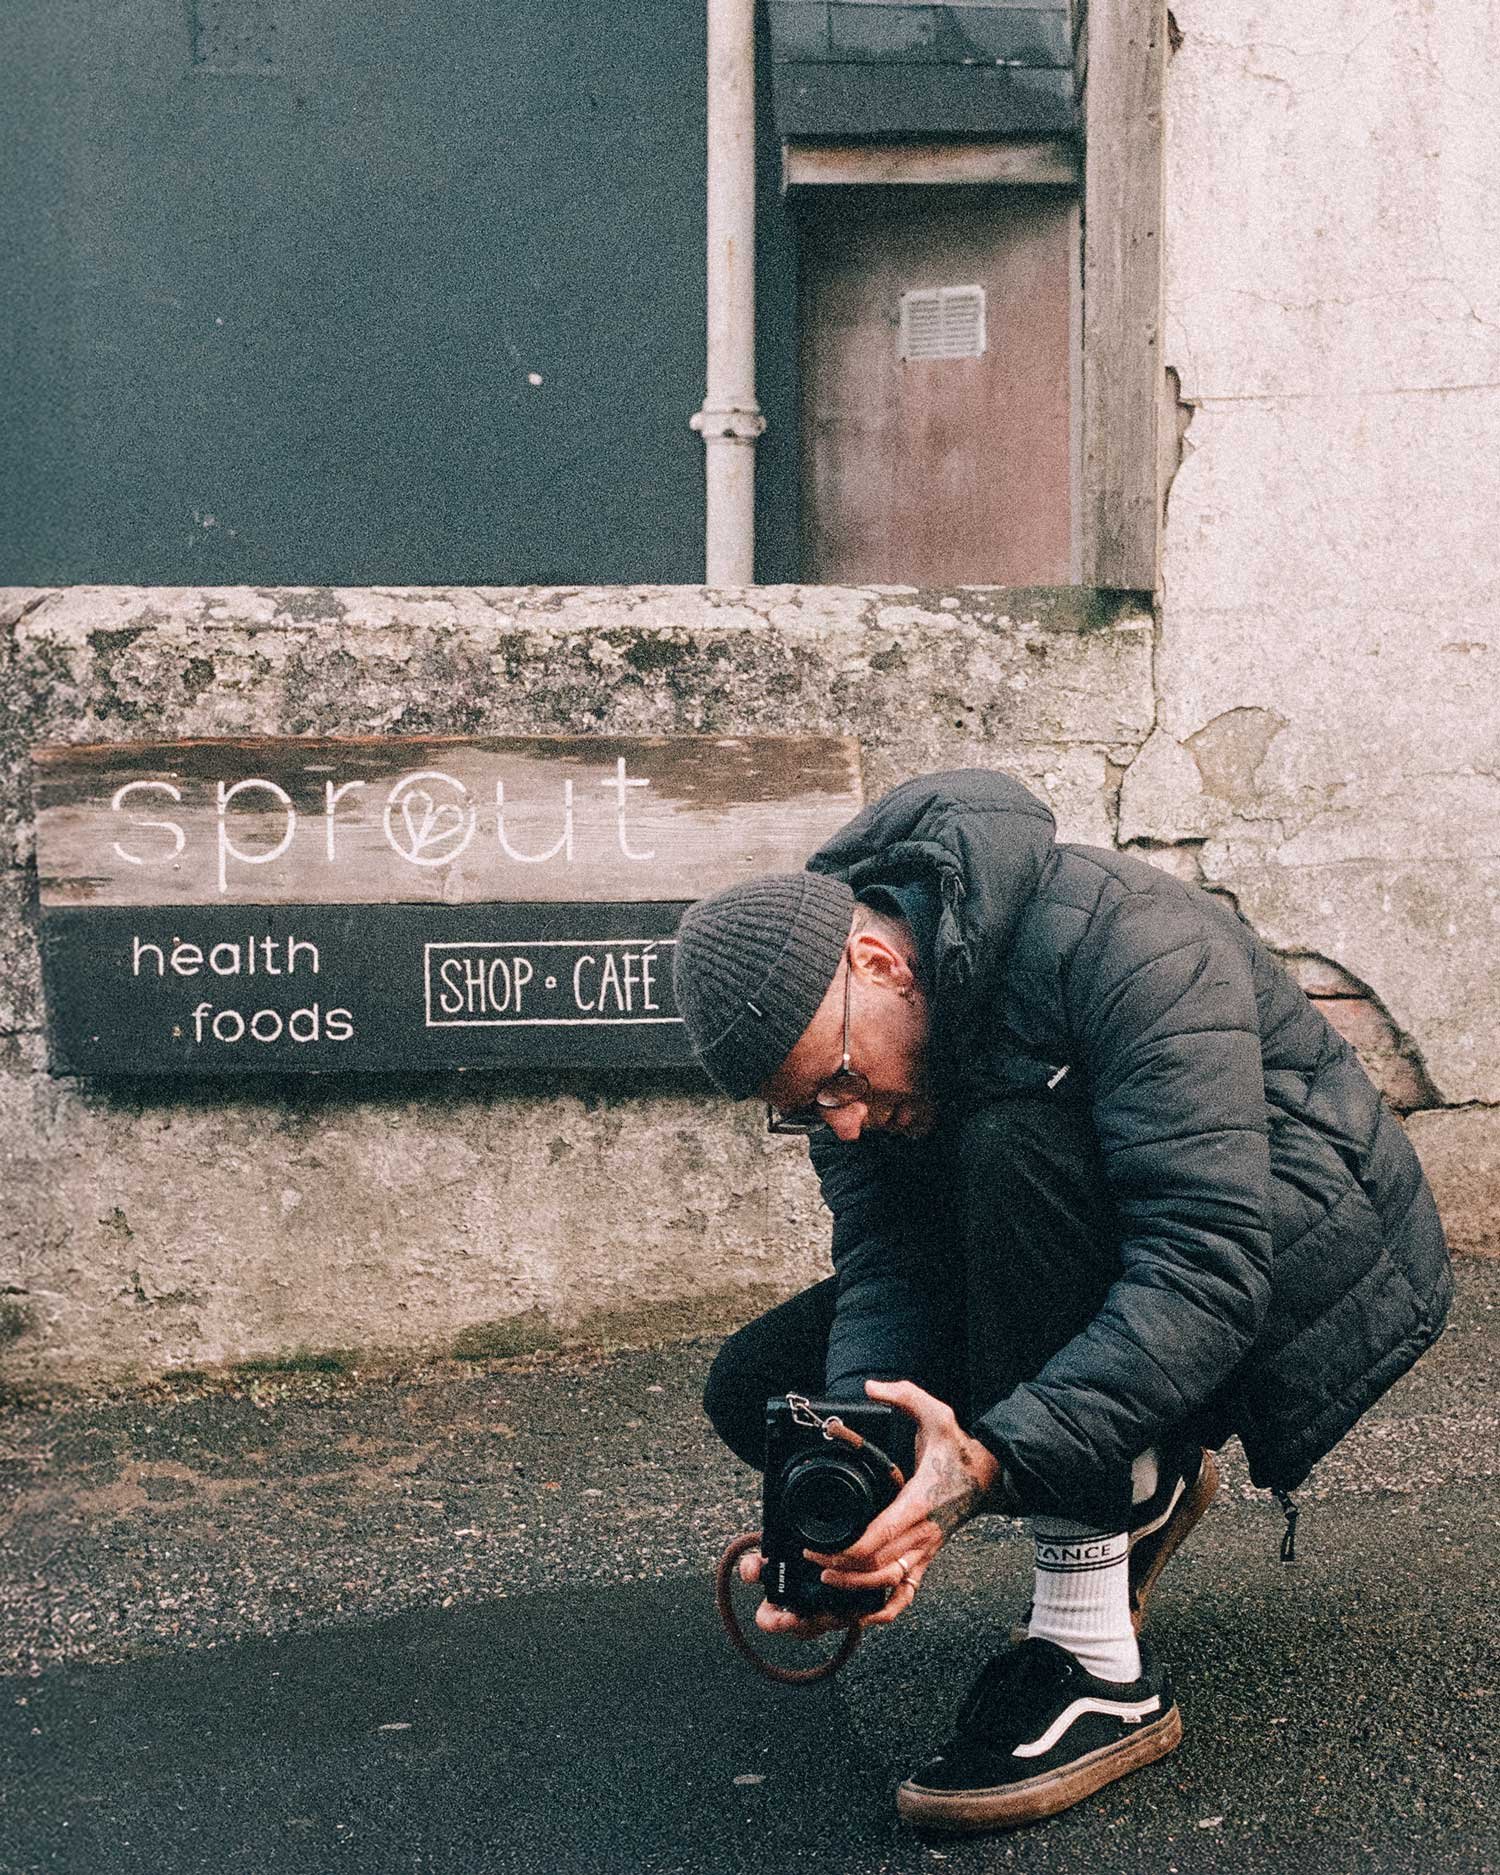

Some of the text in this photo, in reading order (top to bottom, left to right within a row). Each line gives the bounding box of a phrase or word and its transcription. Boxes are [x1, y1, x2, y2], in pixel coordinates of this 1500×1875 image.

[111, 757, 656, 894] sprout
[133, 935, 320, 976] health
[439, 941, 660, 1013] SHOP CAFÉ
[191, 1001, 355, 1043] foods
